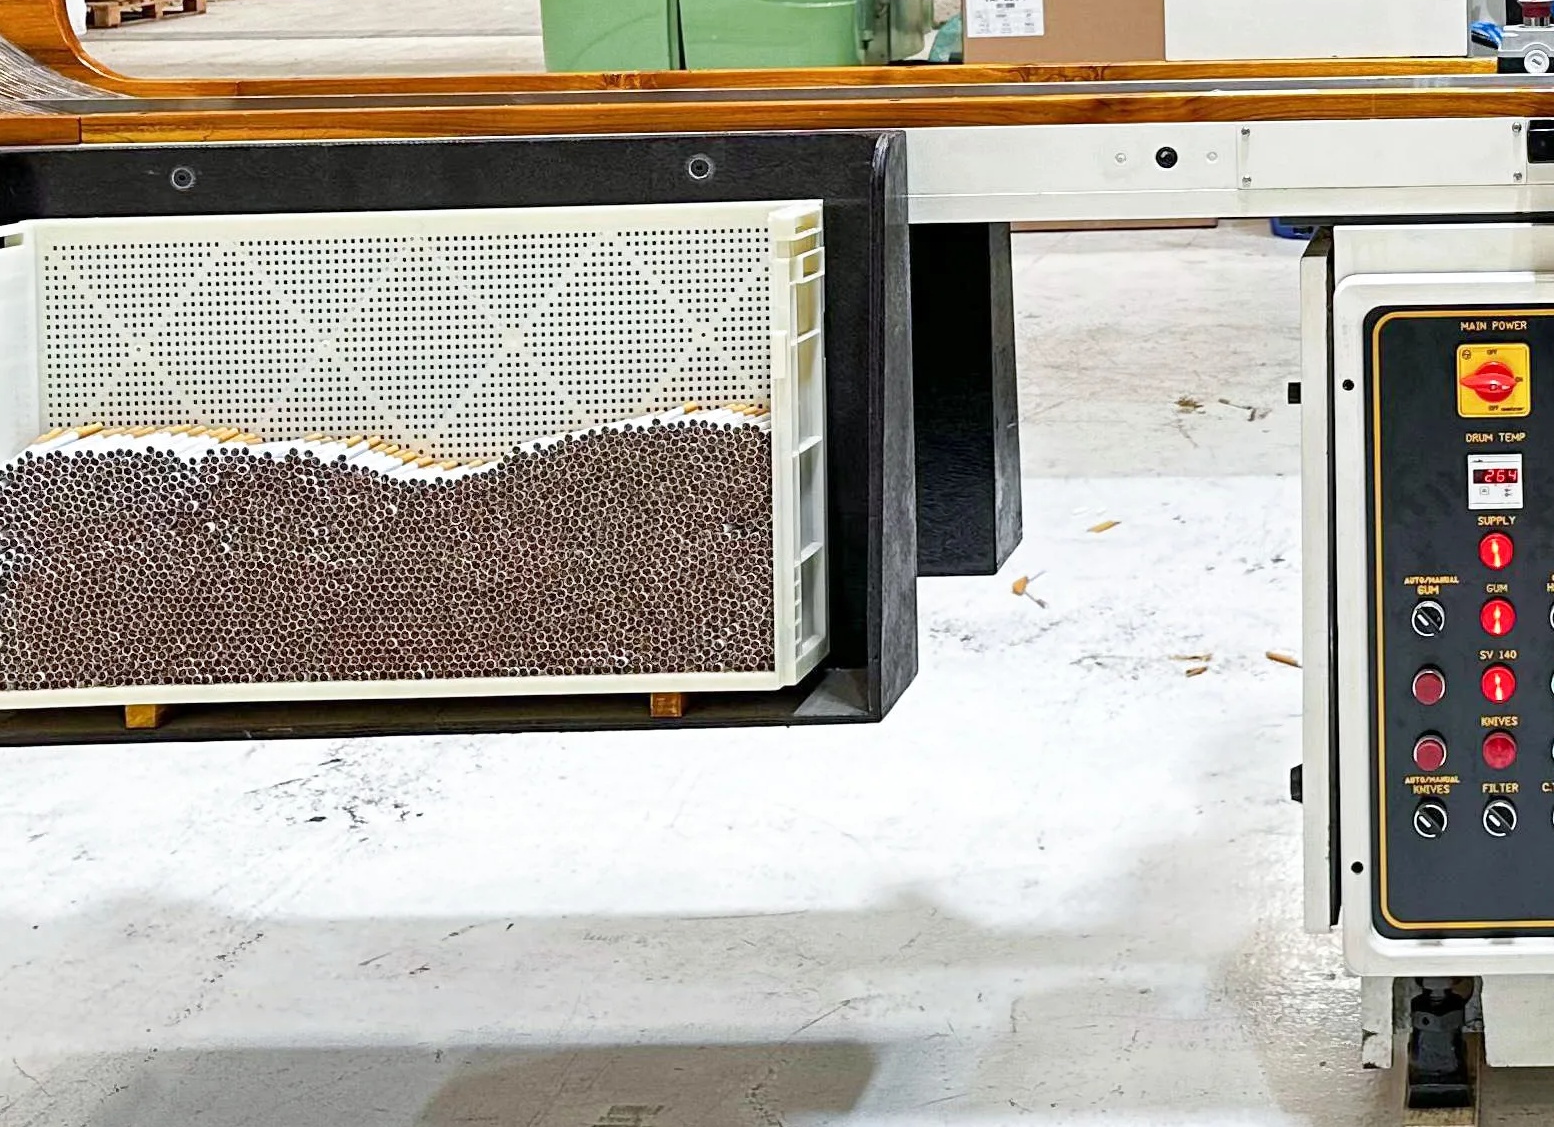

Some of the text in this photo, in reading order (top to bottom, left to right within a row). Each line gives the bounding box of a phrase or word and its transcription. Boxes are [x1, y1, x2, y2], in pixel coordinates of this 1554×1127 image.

[1460, 321, 1528, 331] MAIN POWER
[1465, 432, 1526, 443] DRUM TEMP
[1484, 469, 1517, 483] 264
[1477, 516, 1516, 527] SUPPLY
[1416, 584, 1440, 595] GUM
[1486, 584, 1508, 594] GUM
[1479, 650, 1517, 660] SV 140
[1480, 716, 1518, 727] KNIVES
[1412, 784, 1451, 795] KNIVES
[1482, 783, 1519, 794] FILTER
